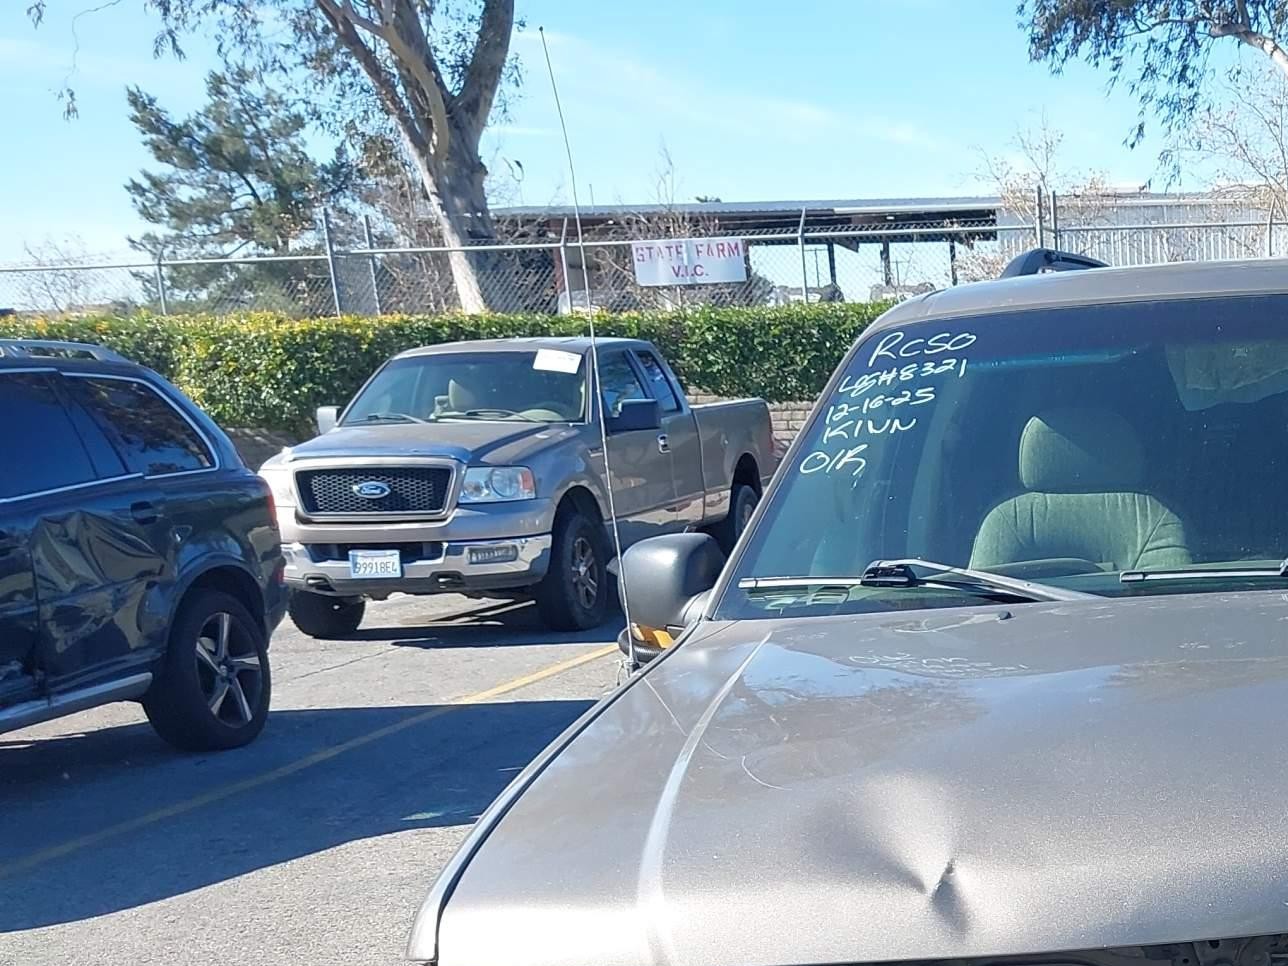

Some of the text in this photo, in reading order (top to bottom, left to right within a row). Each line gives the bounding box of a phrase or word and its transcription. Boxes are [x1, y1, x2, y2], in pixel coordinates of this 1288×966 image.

[636, 242, 740, 262] STATE FARM
[868, 331, 977, 367] RCSO
[825, 387, 936, 425] 12-16-25
